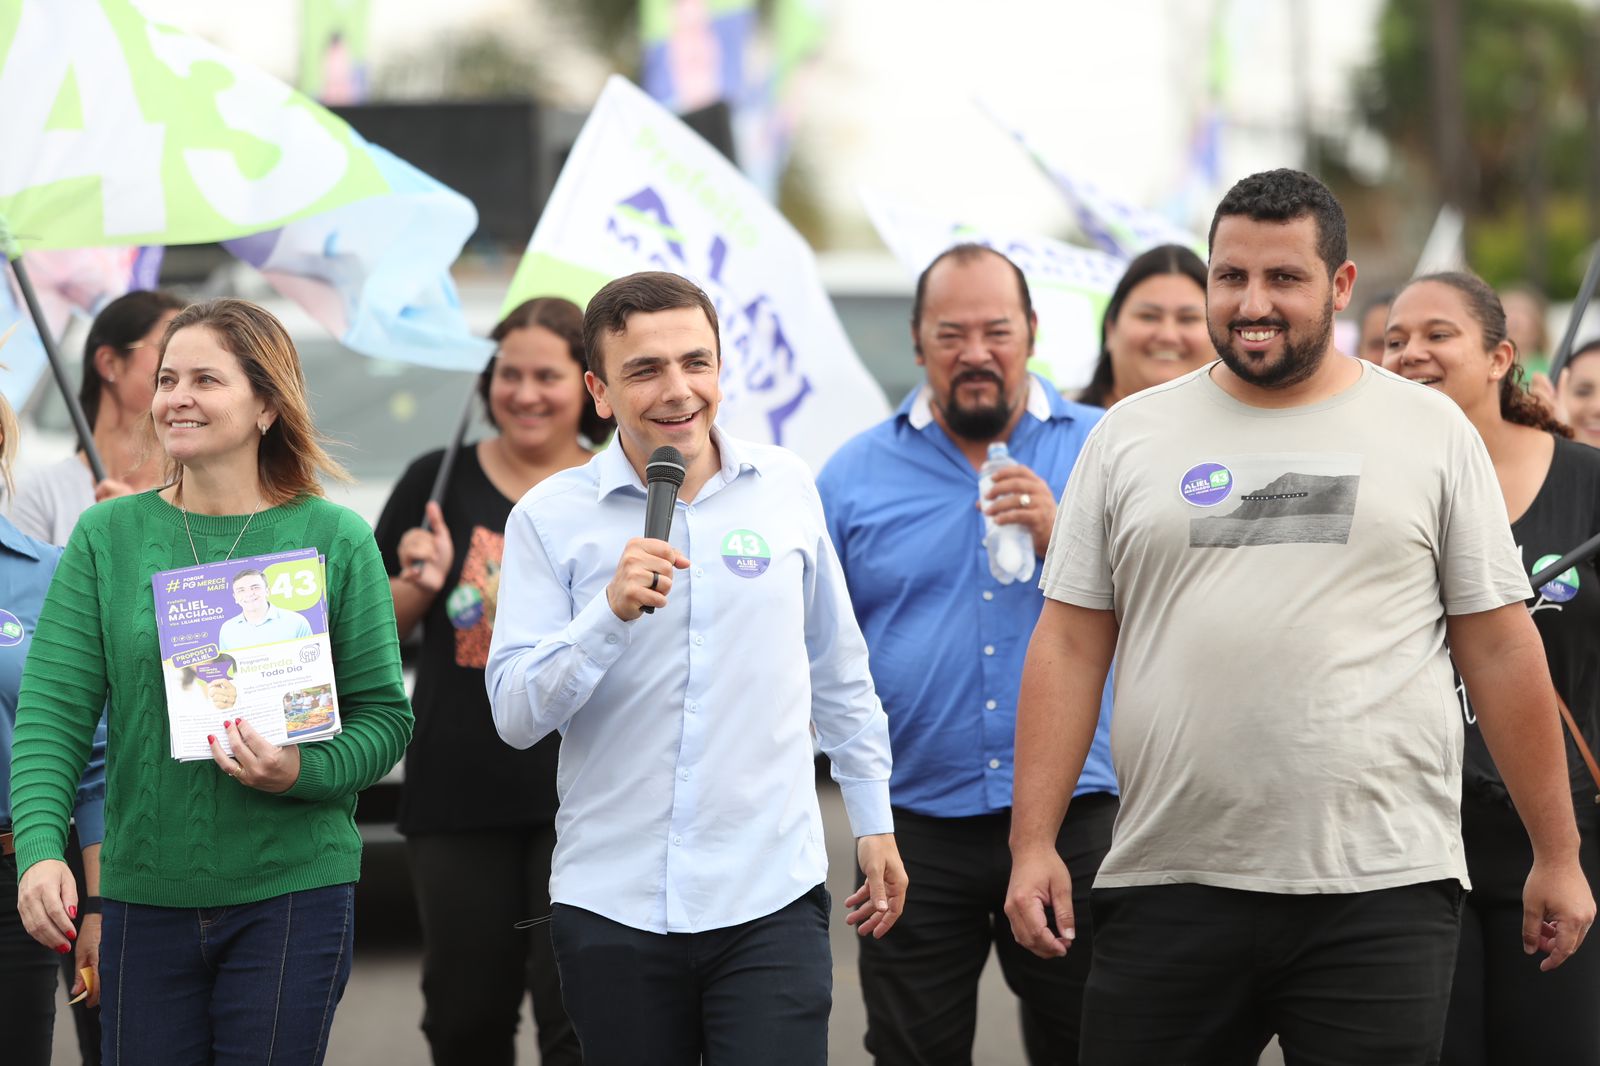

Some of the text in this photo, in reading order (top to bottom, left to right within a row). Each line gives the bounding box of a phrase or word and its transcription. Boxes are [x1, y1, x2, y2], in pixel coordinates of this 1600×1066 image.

[1184, 480, 1210, 490] ALIEL
[1211, 472, 1228, 484] 43
[728, 534, 760, 555] 43
[197, 577, 226, 587] MERECE
[271, 570, 317, 599] 43
[168, 600, 208, 614] ALIEL
[168, 607, 224, 622] MACHADO
[176, 647, 213, 662] PROPOSTA
[192, 653, 212, 663] ALIEL
[240, 658, 293, 673] Merenda
[261, 665, 302, 677] Todo Dia
